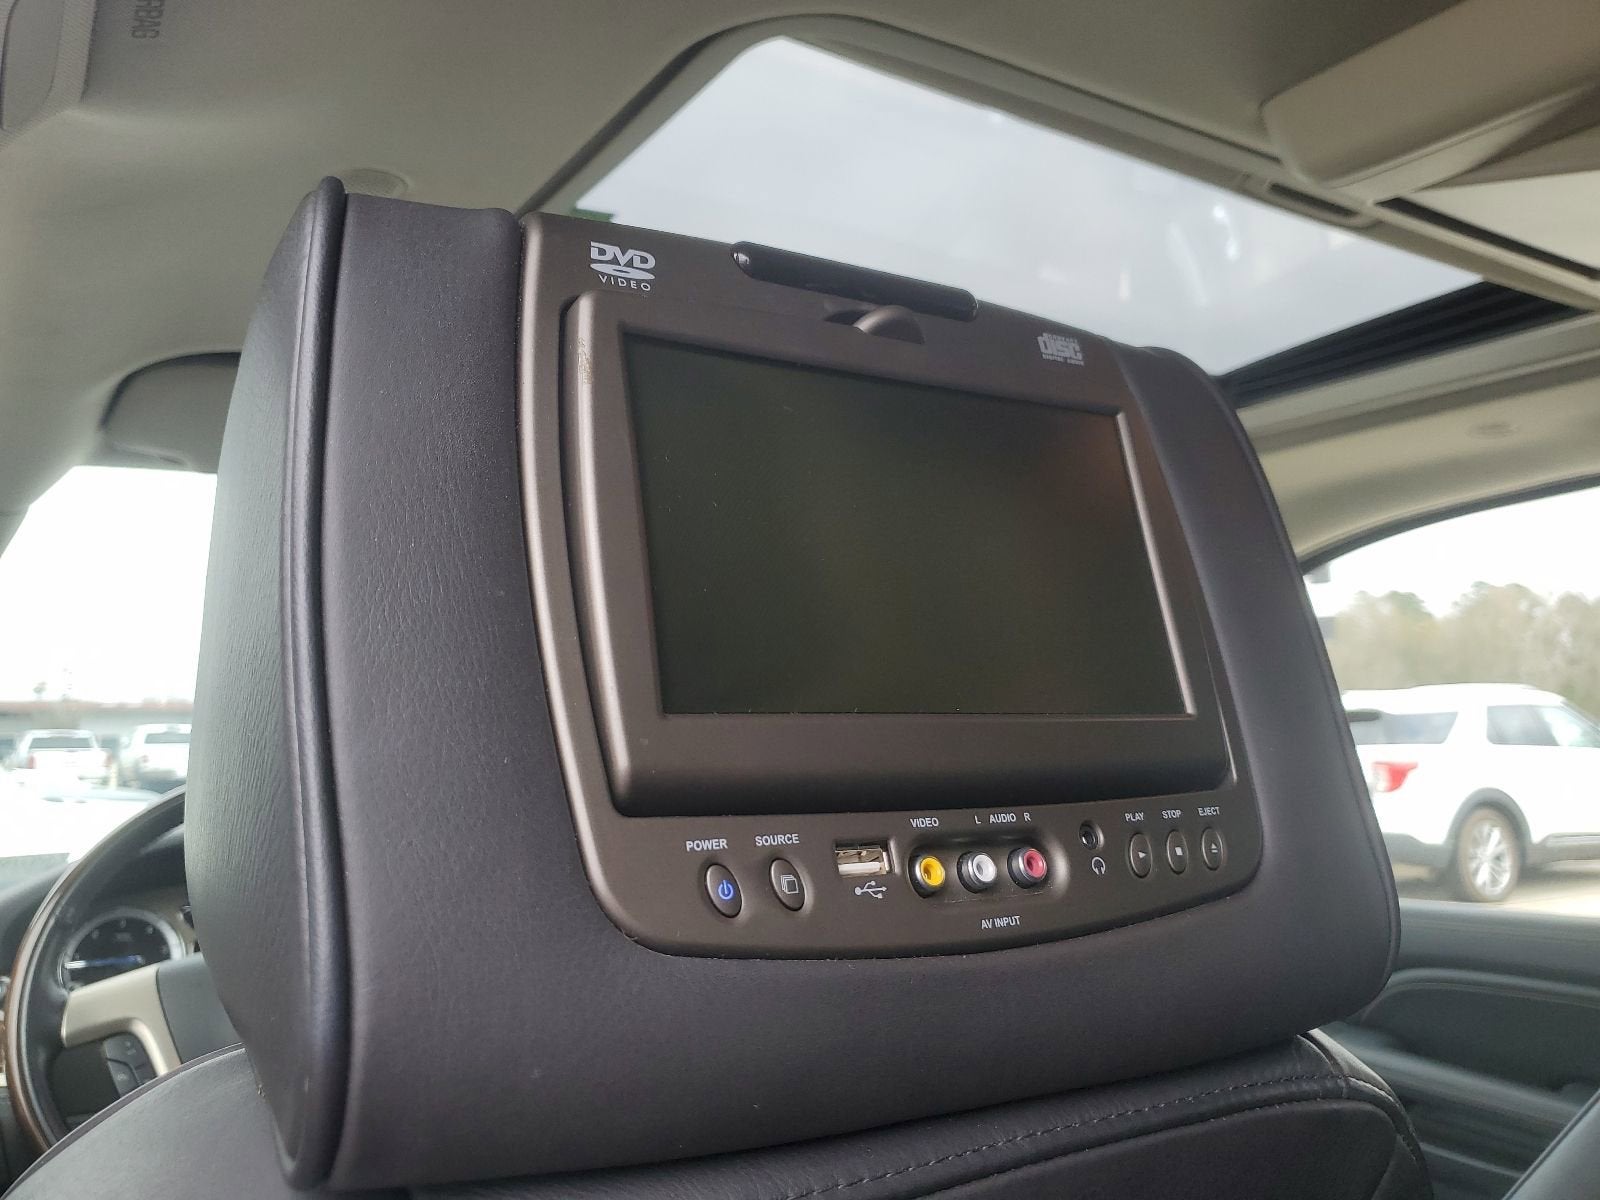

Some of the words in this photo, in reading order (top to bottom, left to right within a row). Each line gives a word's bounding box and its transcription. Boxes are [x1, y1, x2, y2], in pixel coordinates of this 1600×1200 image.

[590, 241, 656, 270] DVD
[598, 274, 651, 291] VIDEO
[1124, 812, 1145, 822] PLAY
[1161, 809, 1182, 819] STOP
[1197, 806, 1220, 816] EJECT
[909, 817, 939, 828] VIDEO
[974, 815, 982, 825] L
[989, 812, 1017, 824] AUDIO
[1023, 812, 1031, 822] R
[686, 838, 728, 851] POWER
[755, 833, 800, 847] SOURCE
[981, 919, 993, 930] AV
[994, 915, 1021, 928] INPUT
